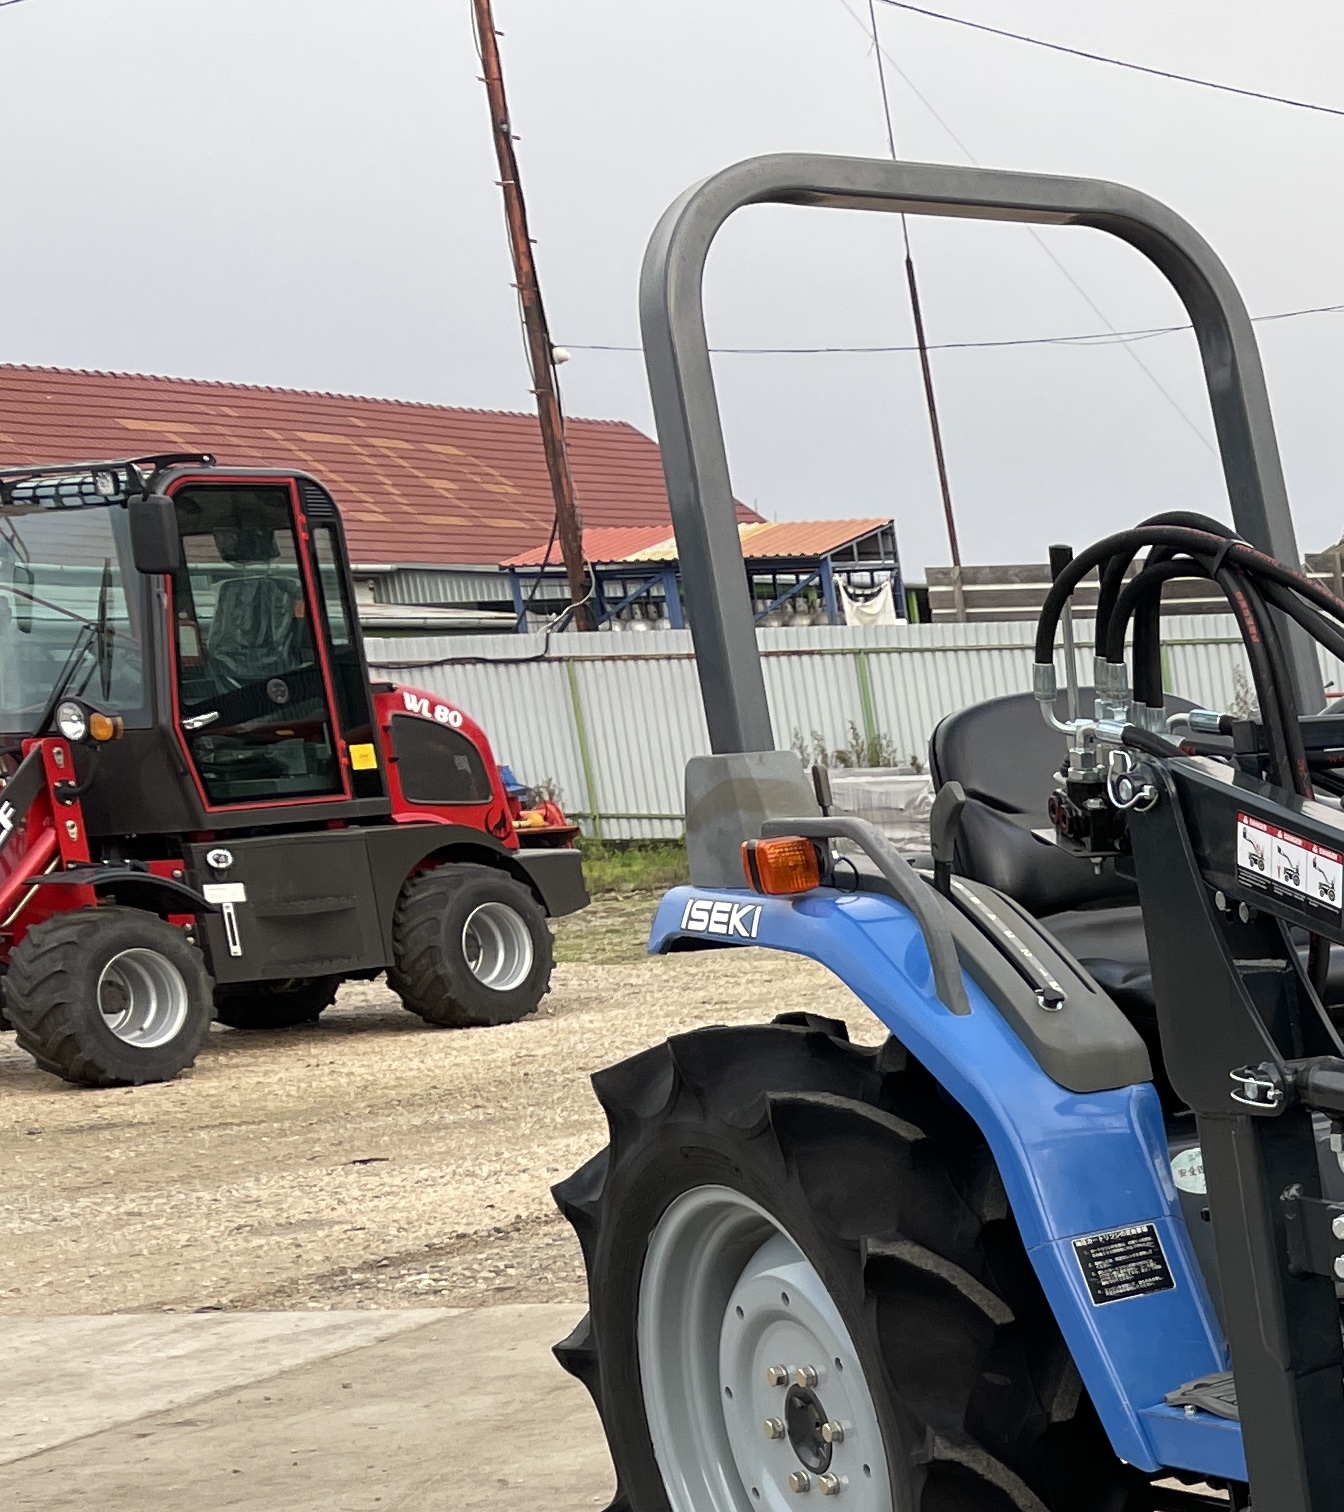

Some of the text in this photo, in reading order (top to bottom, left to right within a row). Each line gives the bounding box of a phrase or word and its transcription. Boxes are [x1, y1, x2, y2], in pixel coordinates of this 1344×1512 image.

[403, 691, 463, 728] WL 80
[680, 899, 763, 938] ISEKI
